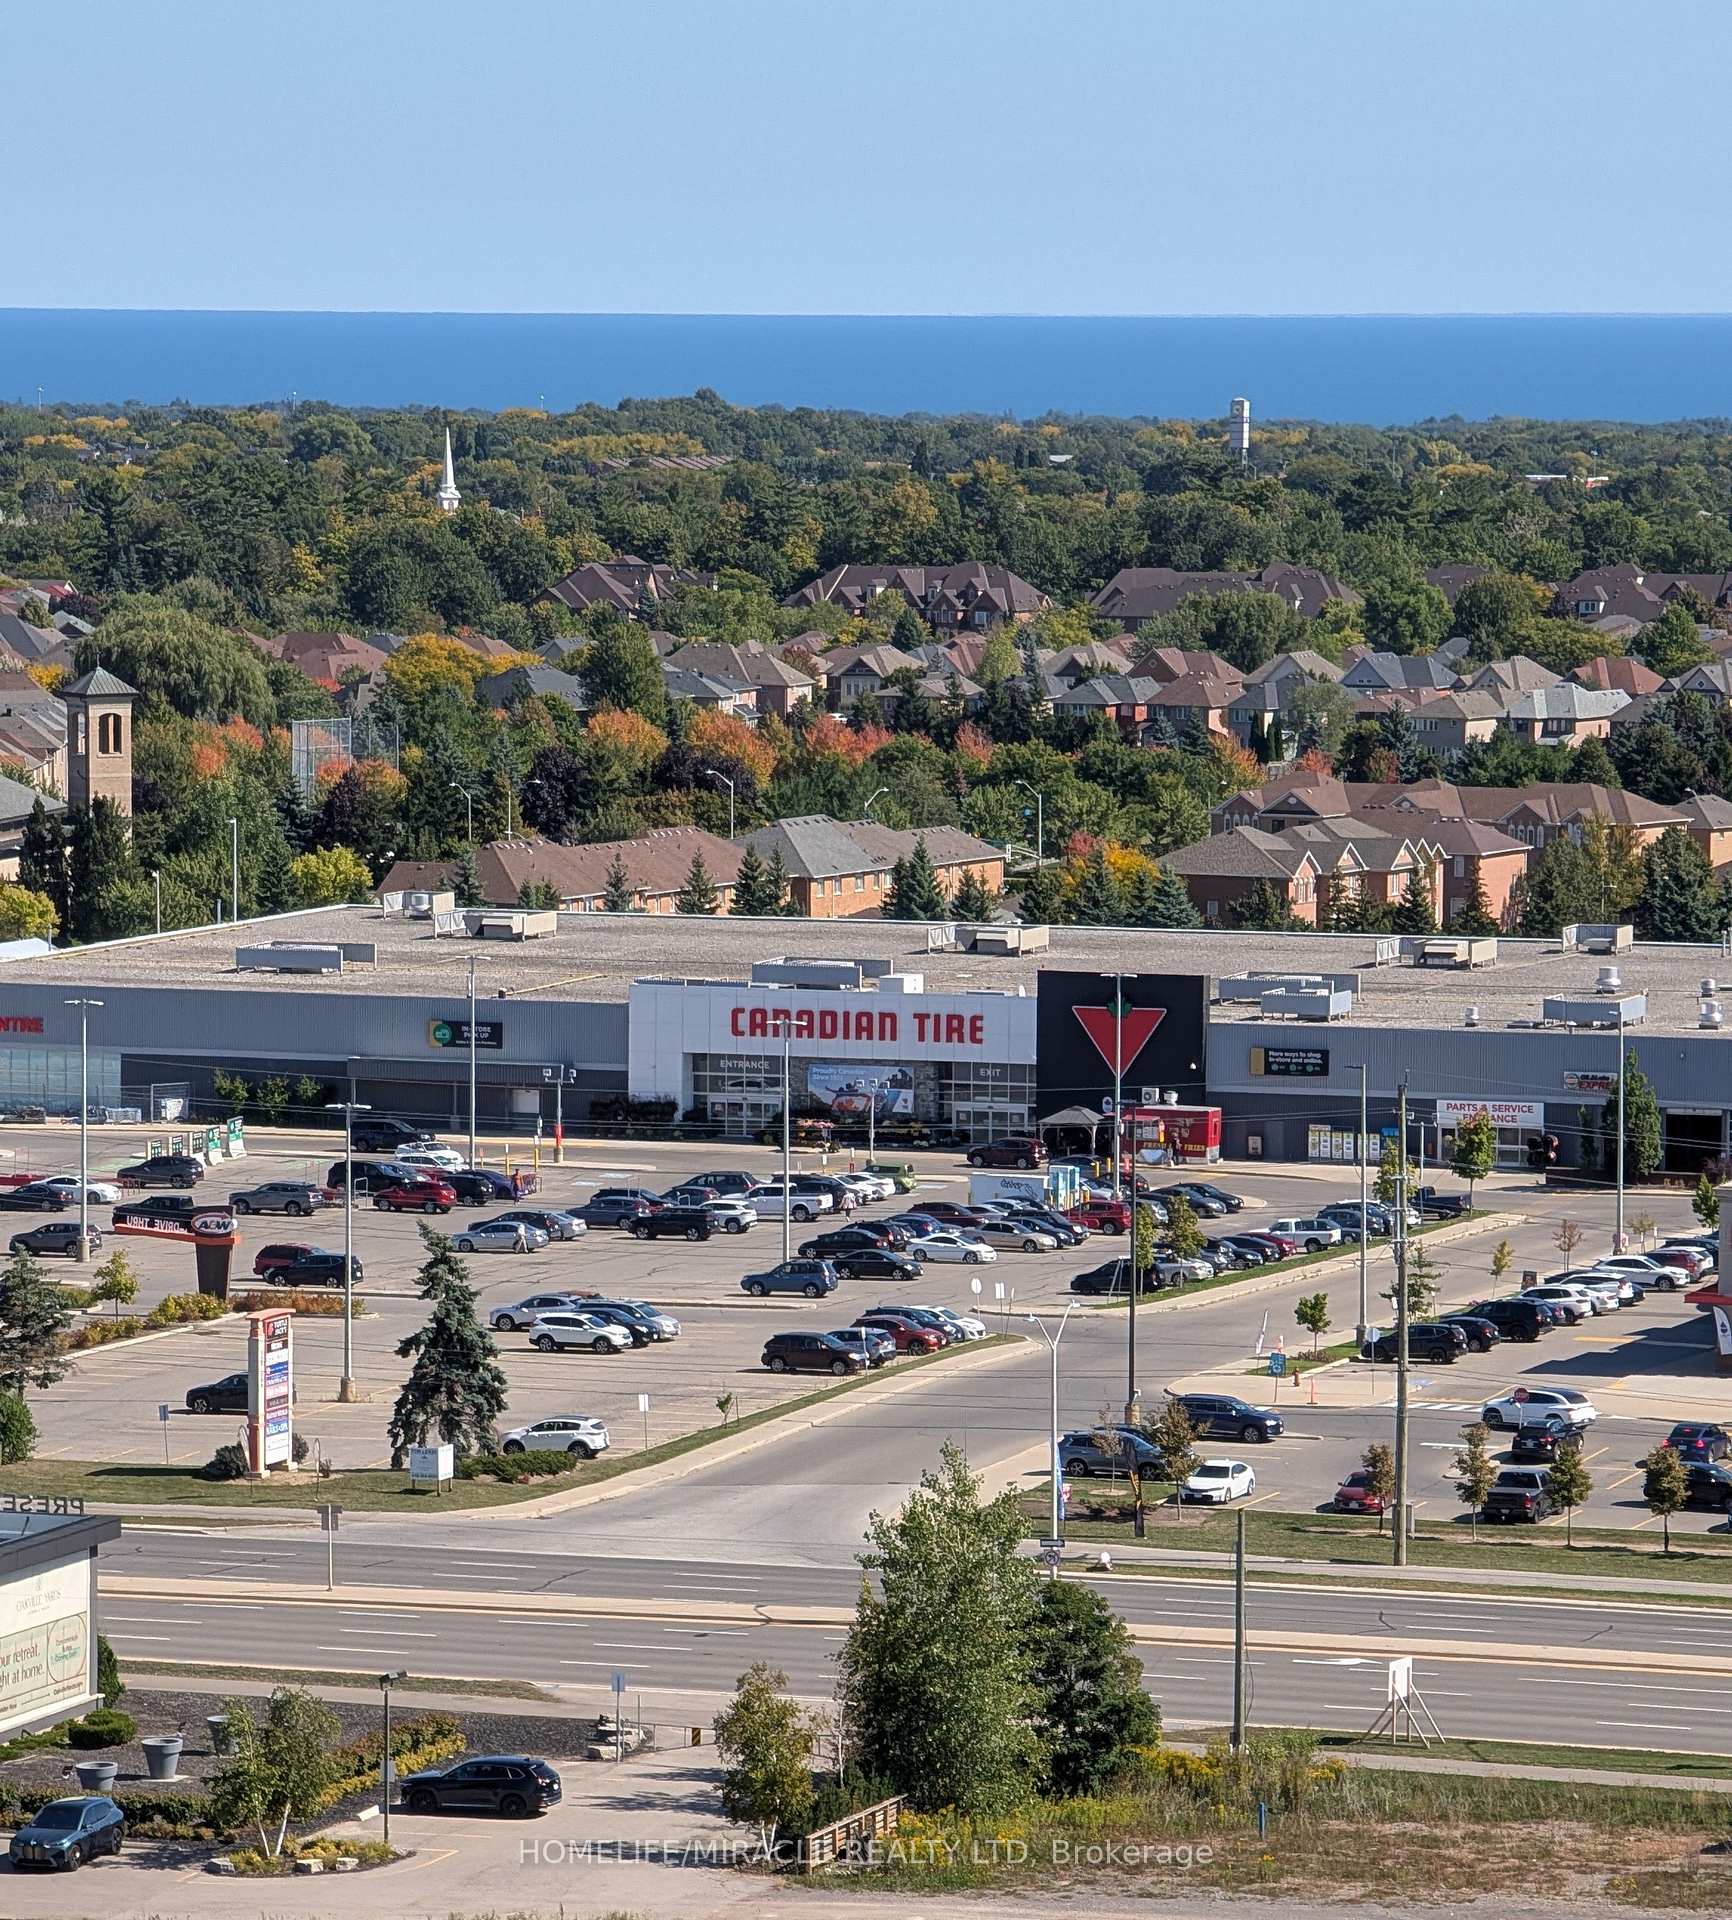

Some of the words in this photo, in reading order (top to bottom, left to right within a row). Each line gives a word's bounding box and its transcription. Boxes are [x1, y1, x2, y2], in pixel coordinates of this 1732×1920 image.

[731, 1007, 897, 1042] CANADIAN
[913, 1013, 984, 1044] TIRE
[720, 1060, 770, 1069] ENTRANCE
[980, 1068, 1001, 1077] EXIT
[1446, 1103, 1477, 1111] PARTS
[1492, 1104, 1534, 1113] SERVICE
[1463, 1114, 1518, 1123] ENANCE
[199, 1219, 232, 1231] A&W
[13, 1643, 40, 1665] retreat.
[12, 1668, 20, 1684] at
[21, 1663, 45, 1682] home.
